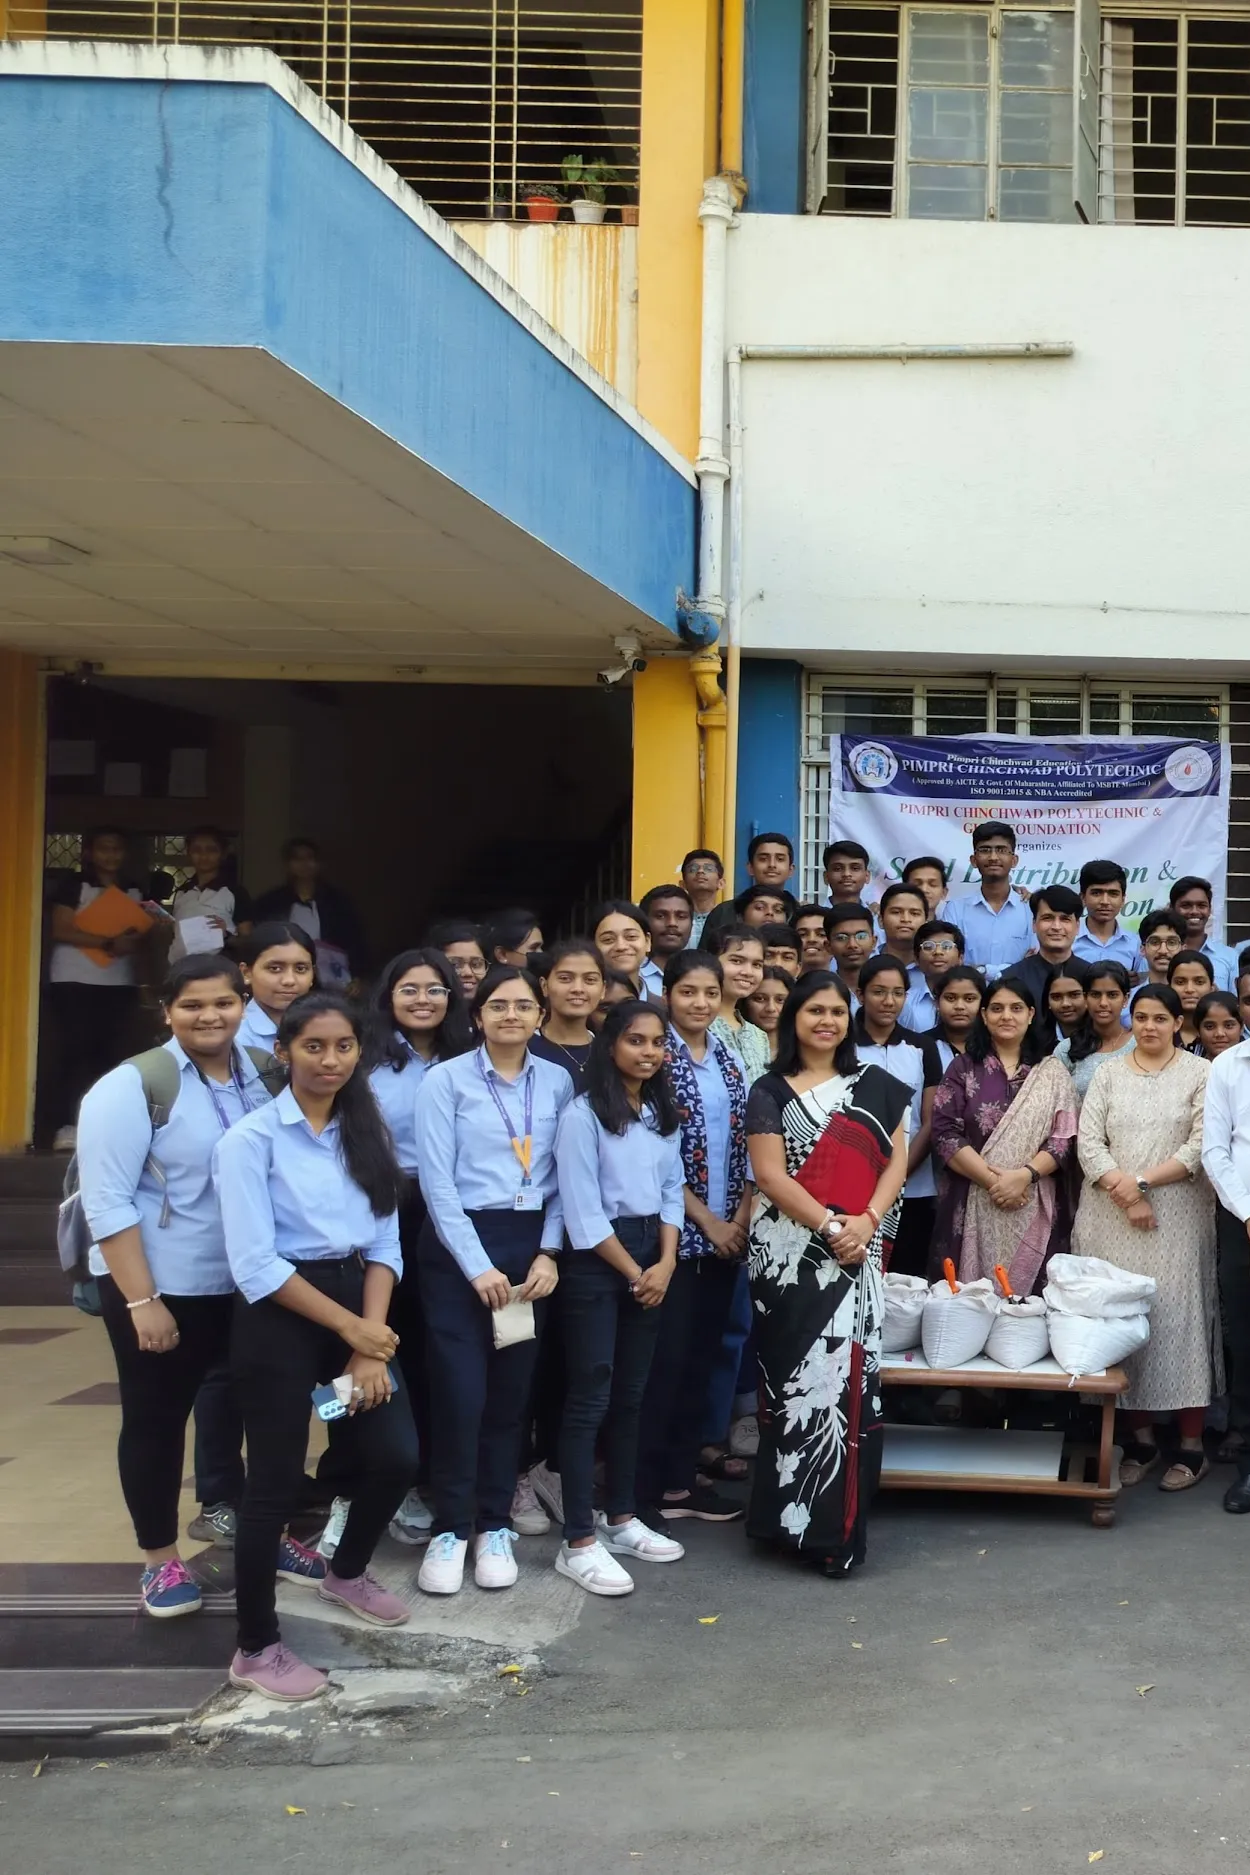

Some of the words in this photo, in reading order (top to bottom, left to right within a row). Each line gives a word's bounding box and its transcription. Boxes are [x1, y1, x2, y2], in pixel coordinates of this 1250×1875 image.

[947, 754, 979, 764] Pimpri
[981, 756, 1033, 766] Chinchwad
[902, 759, 954, 773] PIMPRI
[957, 764, 1052, 775] CHINCHWAD
[1056, 764, 1162, 777] POLYTECHNIC
[916, 777, 945, 785] Approved
[945, 778, 954, 786] By
[955, 778, 977, 786] AICTE
[1004, 779, 1013, 787] Of
[1057, 780, 1086, 788] Affiliated
[1096, 781, 1121, 789] MSBTE
[970, 787, 985, 795] ISO
[986, 787, 1024, 796] 9001:2015
[1025, 788, 1032, 796] &
[1034, 789, 1053, 797] NBA
[1053, 789, 1092, 797] Accredited
[900, 803, 949, 817] PIMPRI
[953, 806, 1044, 819] CHINCHWAD
[1047, 806, 1149, 819] POLYTECHNIC
[1153, 807, 1162, 817] &
[1017, 842, 1062, 853] rganizes
[884, 856, 957, 883] Sd
[1158, 859, 1180, 881] &
